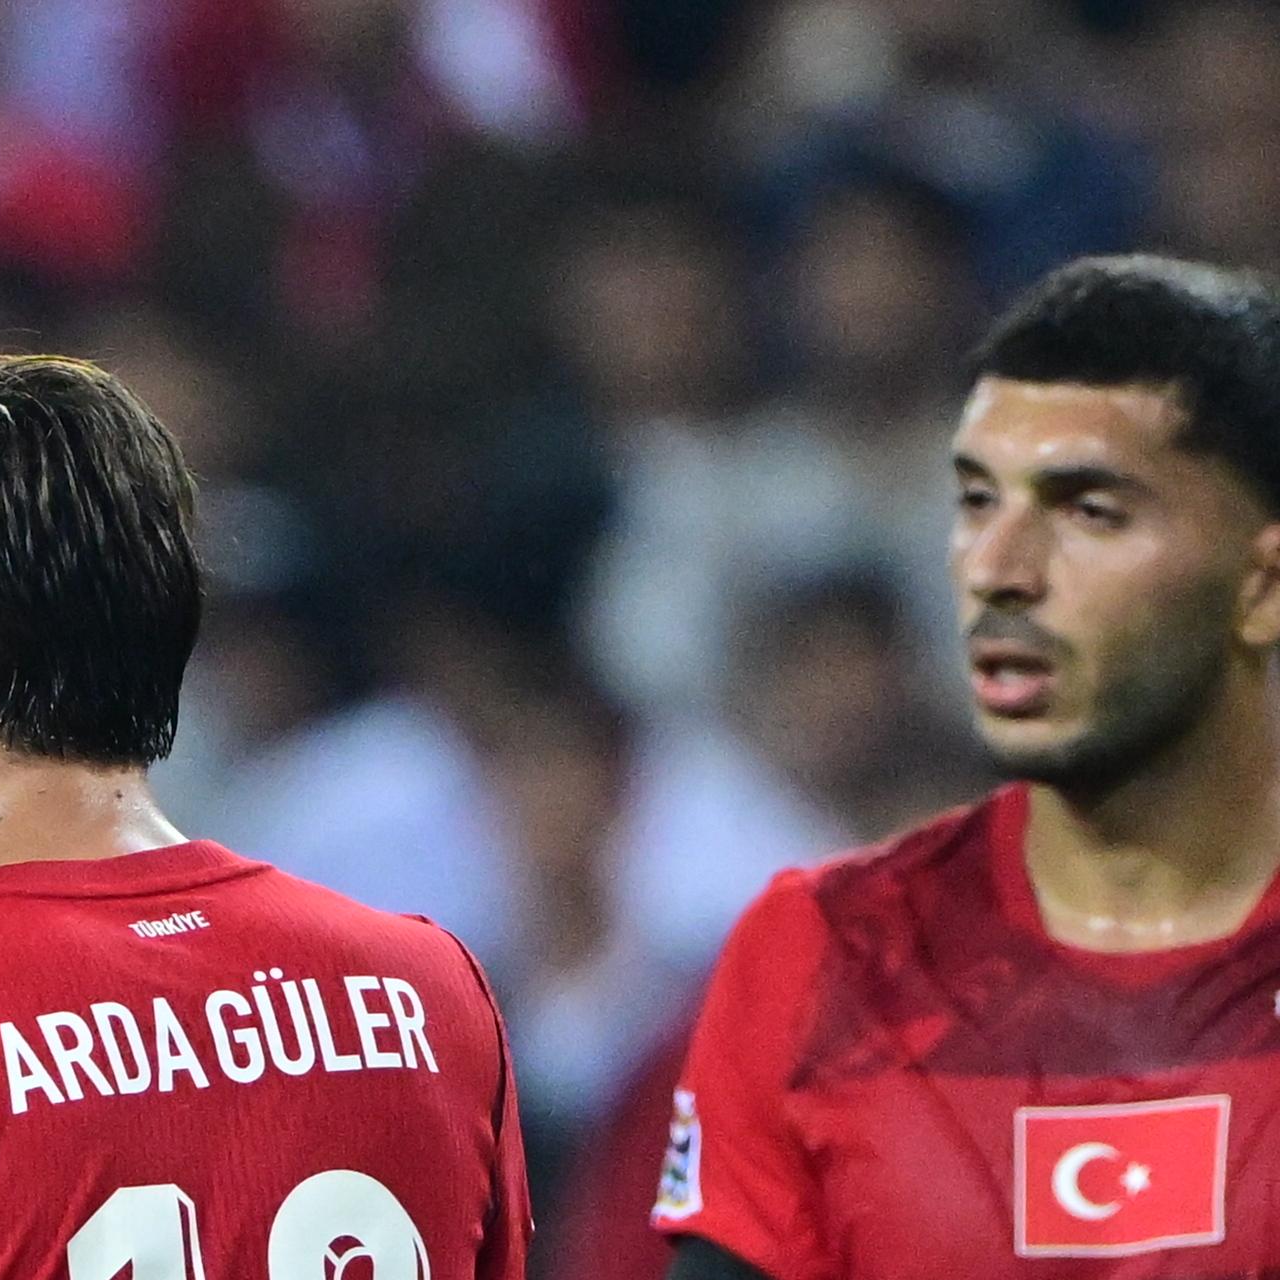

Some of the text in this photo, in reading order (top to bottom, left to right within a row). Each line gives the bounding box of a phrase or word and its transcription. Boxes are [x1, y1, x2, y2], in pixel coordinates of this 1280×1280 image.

[127, 910, 211, 938] TÜRKİYE
[0, 967, 440, 1115] ARDA GÜLER
